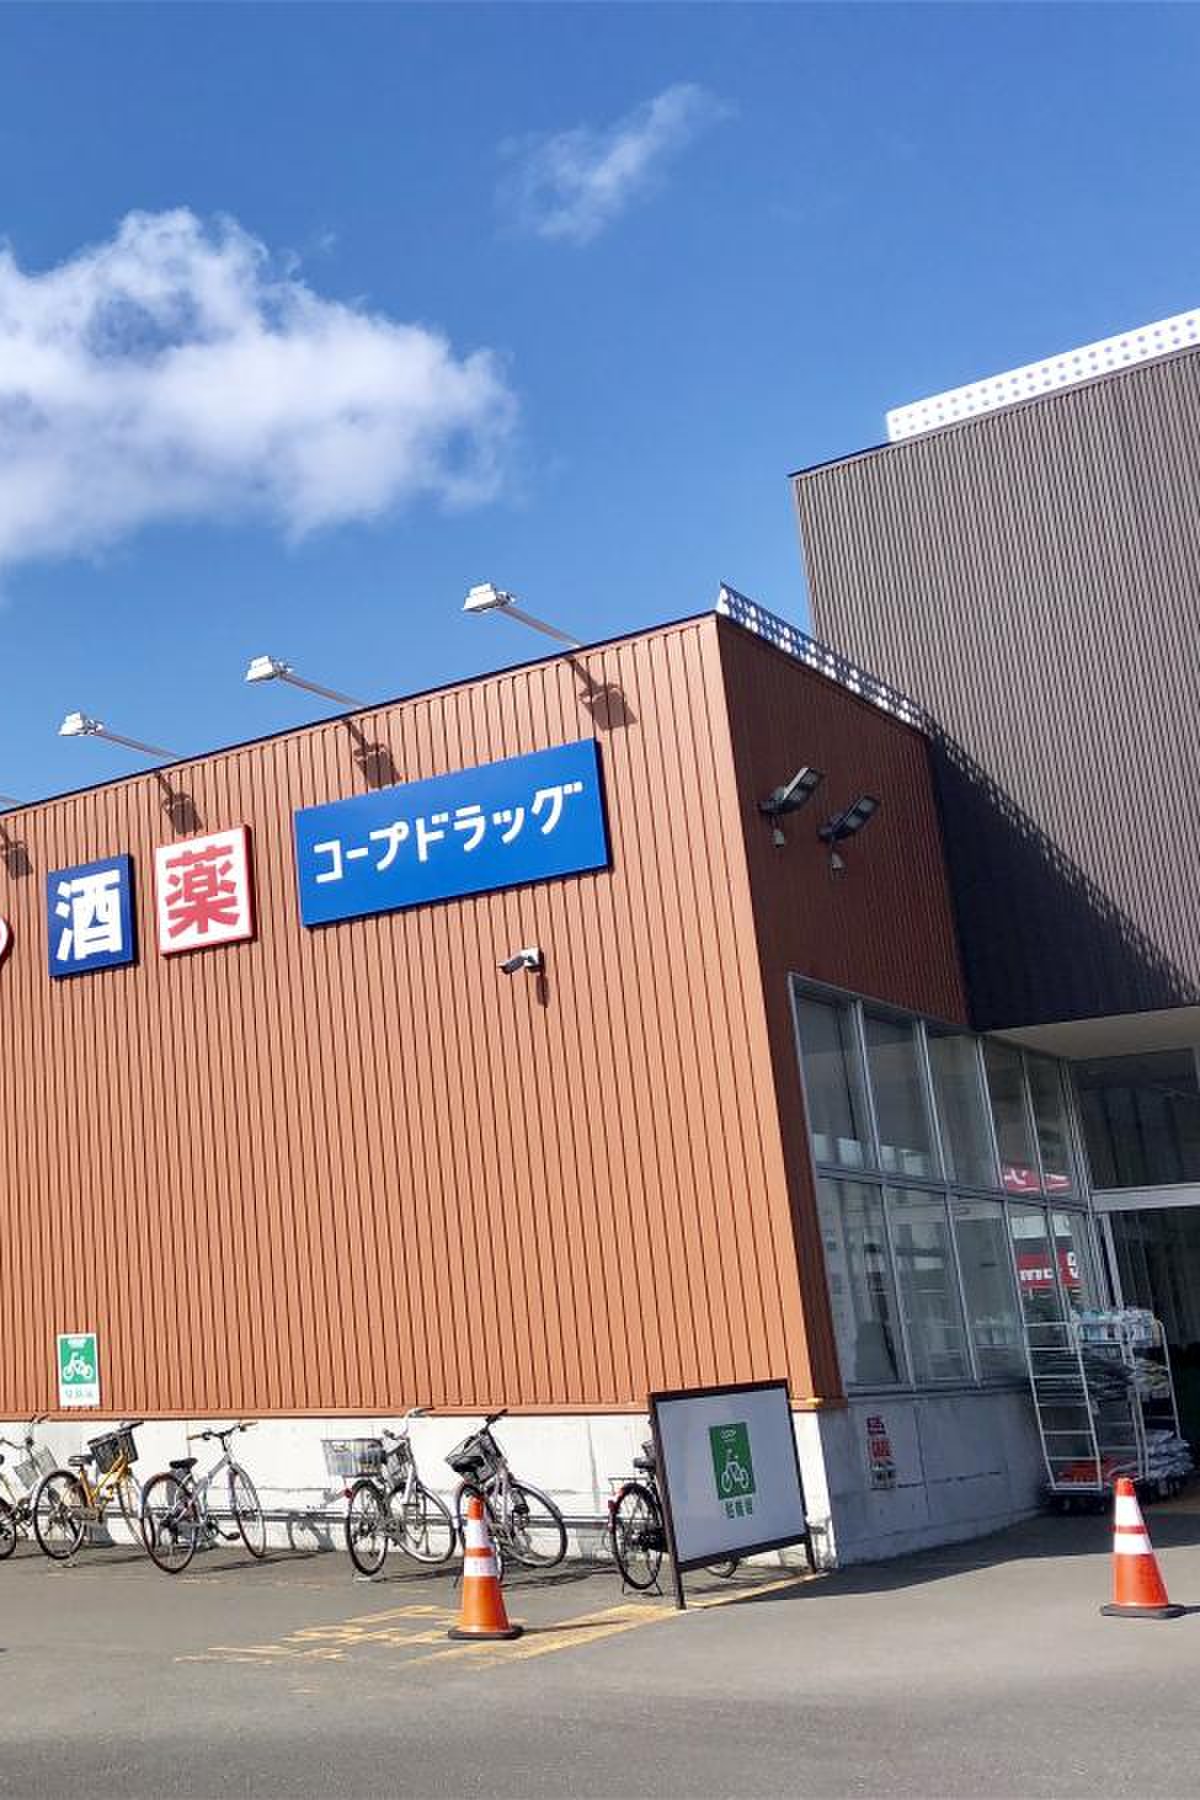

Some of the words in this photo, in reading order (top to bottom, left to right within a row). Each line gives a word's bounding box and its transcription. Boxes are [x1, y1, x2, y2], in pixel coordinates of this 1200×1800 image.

[313, 781, 584, 883] コープドラッグ
[56, 868, 122, 961] 酒
[165, 844, 240, 939] 薬
